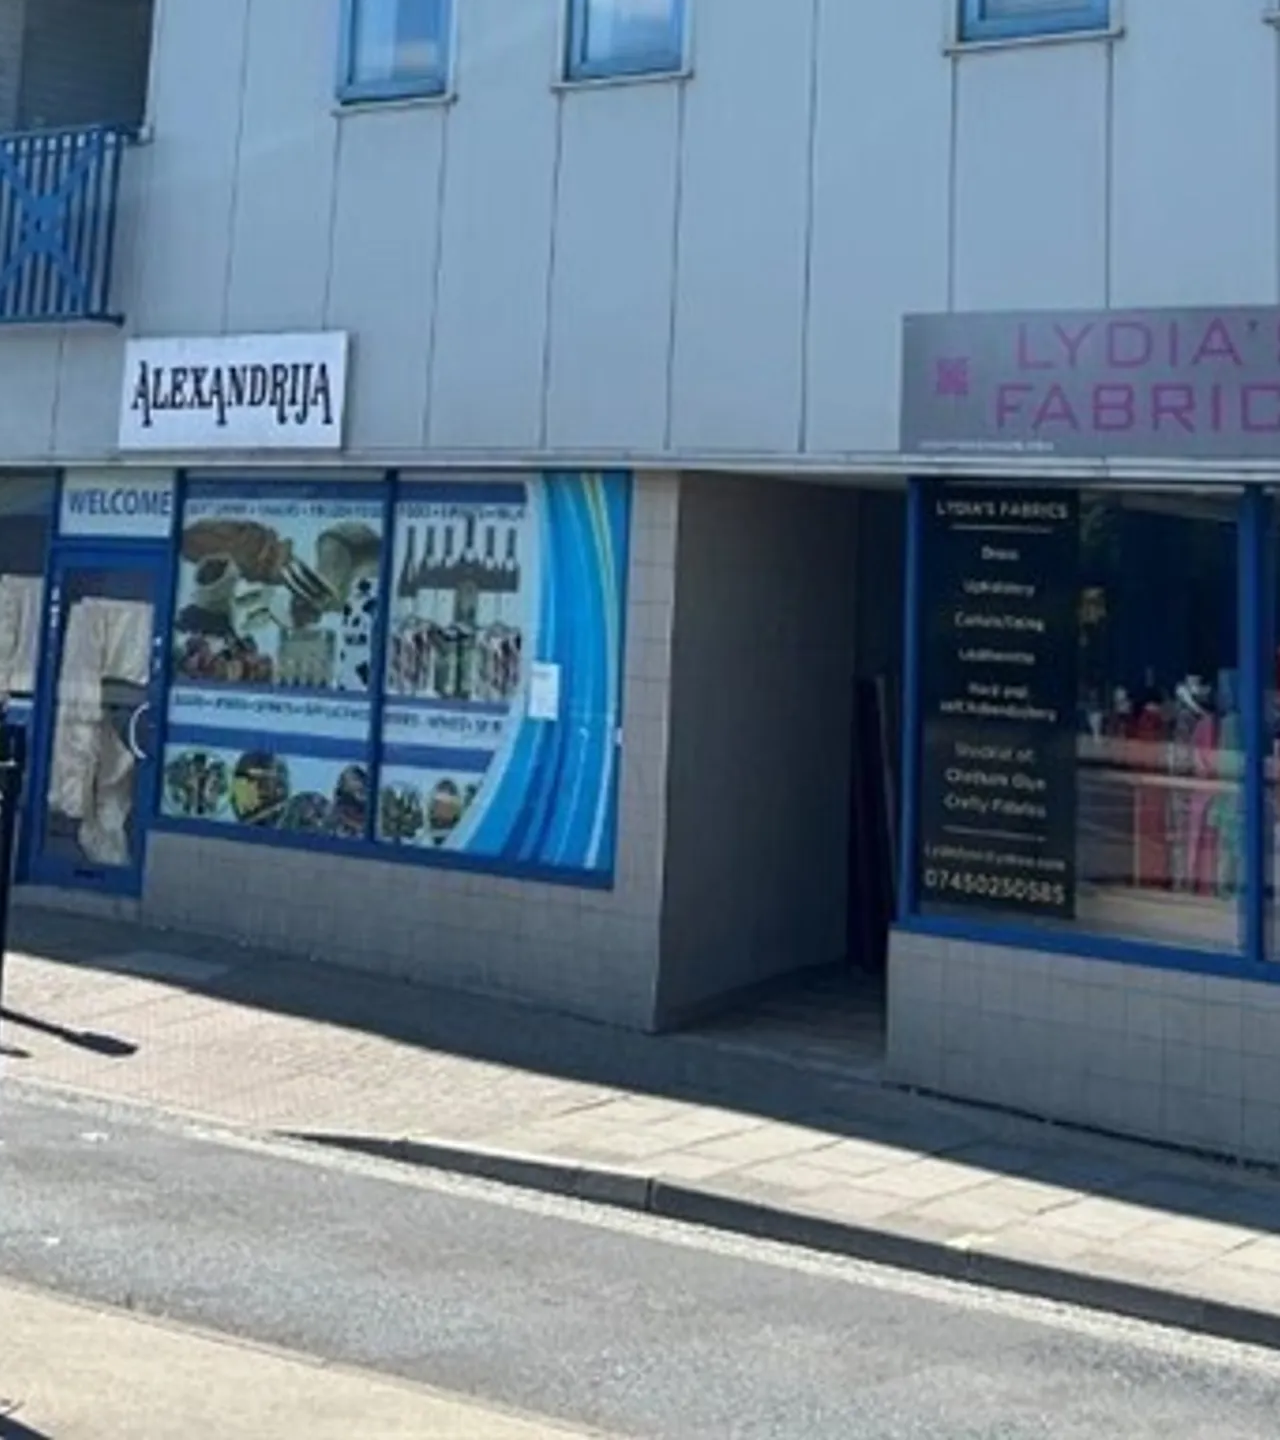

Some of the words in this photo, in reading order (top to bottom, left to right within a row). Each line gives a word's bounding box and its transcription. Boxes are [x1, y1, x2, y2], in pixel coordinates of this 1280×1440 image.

[130, 360, 334, 428] ALEXANDRIJA
[67, 487, 173, 516] WELCOME
[999, 500, 1069, 520] FABRICS
